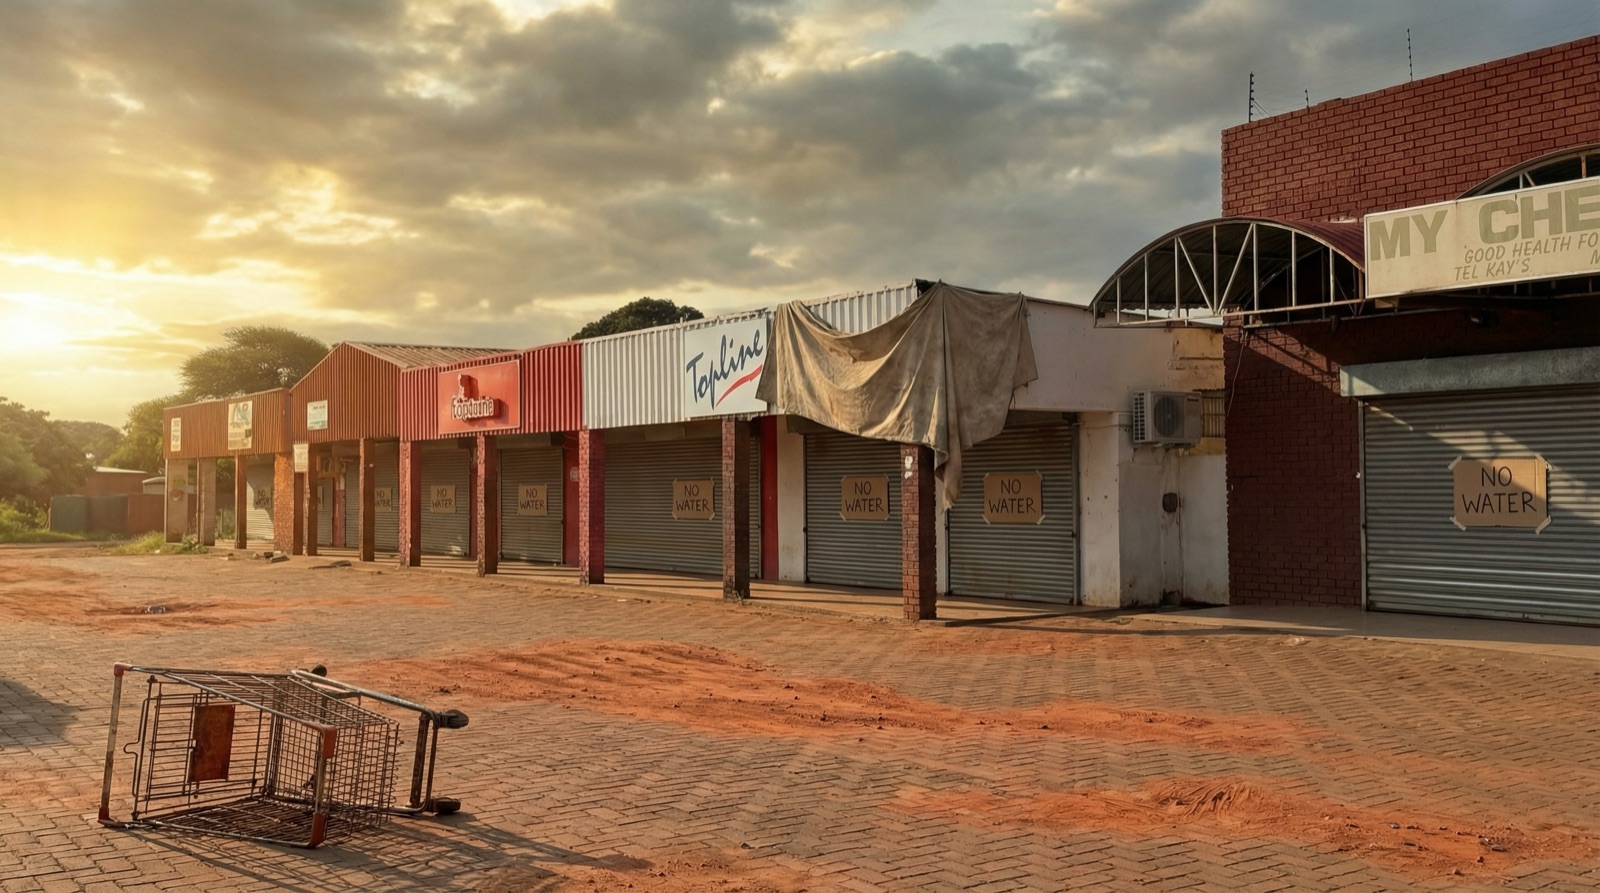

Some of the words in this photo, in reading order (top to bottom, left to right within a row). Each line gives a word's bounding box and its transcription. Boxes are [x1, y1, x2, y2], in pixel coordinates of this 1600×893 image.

[1370, 210, 1449, 262] MY
[1478, 185, 1600, 245] CHE
[1464, 245, 1506, 264] GOOD
[1512, 236, 1572, 258] HEALTH
[1578, 231, 1599, 250] FO
[1454, 264, 1479, 281] TEL
[1485, 258, 1531, 278] KAY'S
[686, 329, 764, 411] Topline
[1481, 466, 1513, 487] NO
[436, 487, 447, 498] NO
[525, 487, 538, 499] NO
[684, 484, 700, 497] NO
[854, 481, 872, 496] NO
[1000, 478, 1022, 495] NO
[375, 498, 391, 507] ATER
[431, 498, 454, 509] WATER
[519, 500, 546, 510] WATER
[675, 498, 710, 512] WATER
[844, 497, 884, 513] WATER
[988, 497, 1037, 515] WATER
[1461, 491, 1537, 514] WATER
